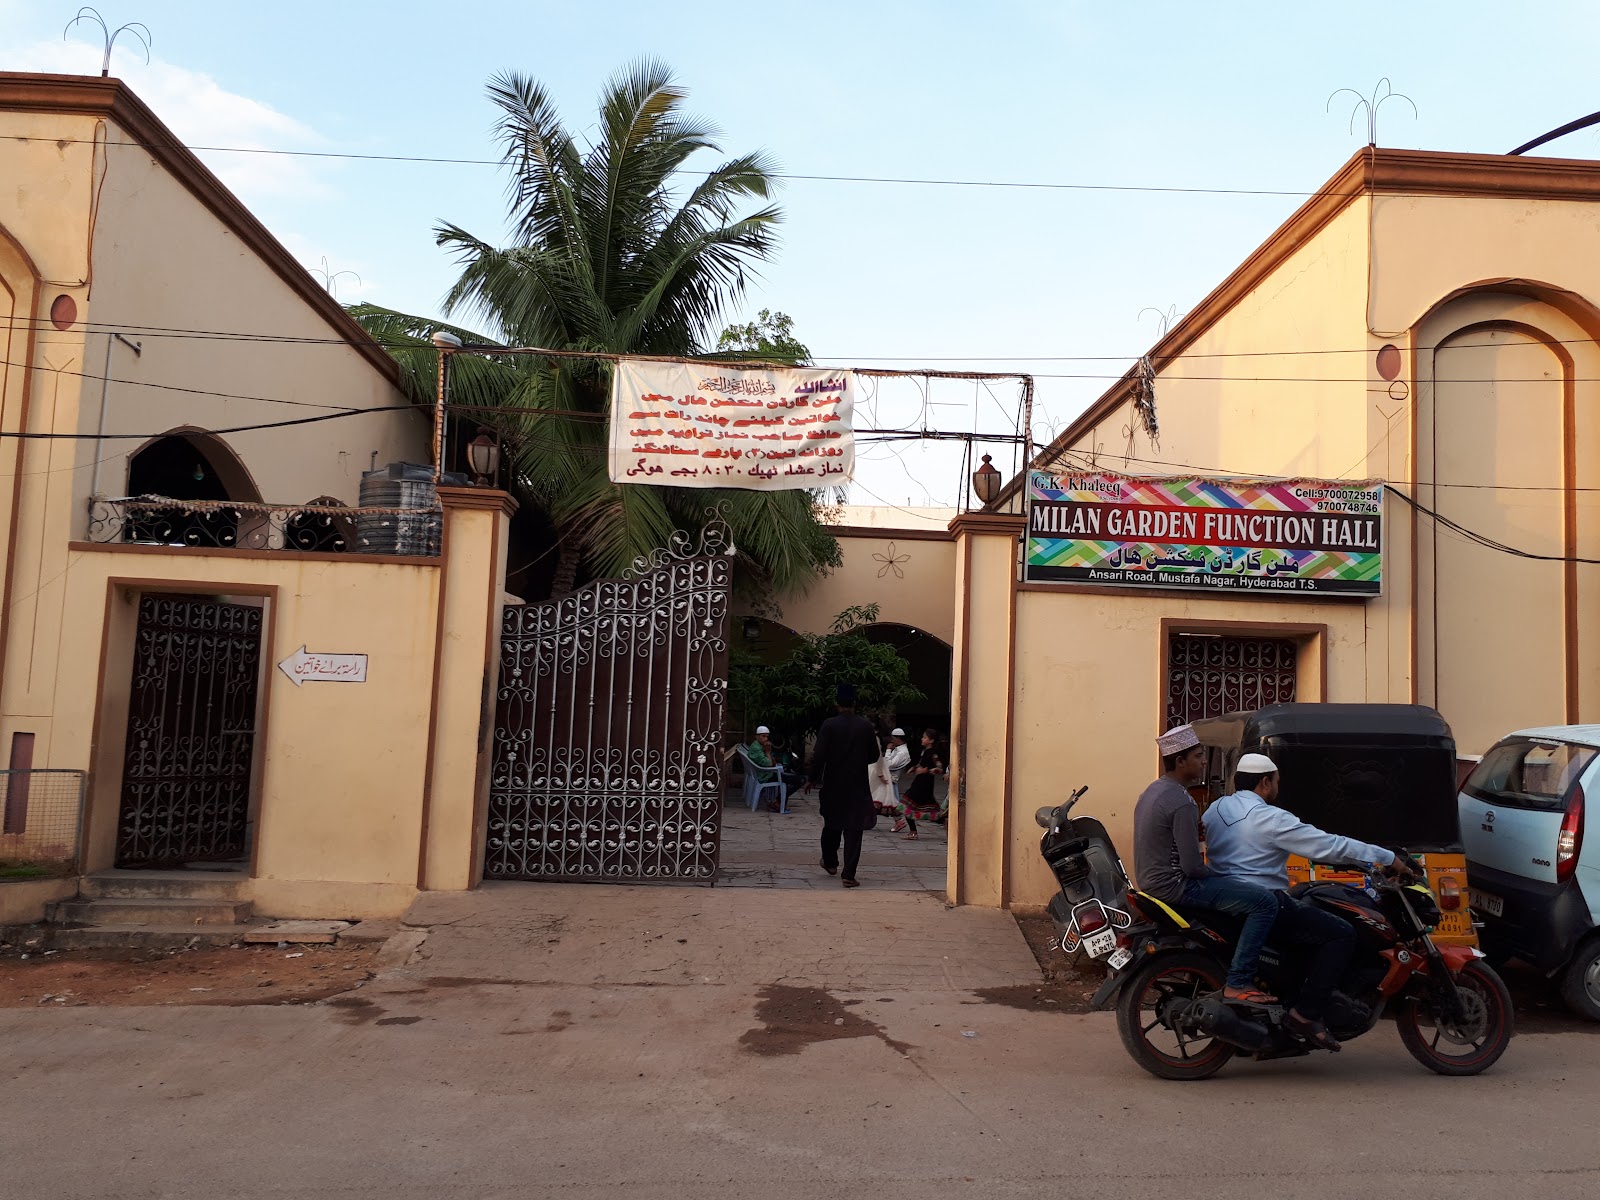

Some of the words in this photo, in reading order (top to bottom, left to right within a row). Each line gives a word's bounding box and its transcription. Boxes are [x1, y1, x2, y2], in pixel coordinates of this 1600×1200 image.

[818, 461, 844, 477] نماز
[1068, 477, 1122, 496] Khaleeq
[1317, 502, 1378, 513] 9700748746
[1032, 505, 1102, 534] MILAN
[1107, 509, 1197, 539] GARDEN
[1203, 513, 1316, 544] FUNCTION
[1321, 518, 1377, 549] HALL
[1266, 555, 1299, 576] ملن
[1088, 569, 1123, 581] Ansari
[1126, 571, 1156, 583] Road,
[1159, 572, 1201, 584] Mustafa
[1203, 575, 1237, 588] Nagar,
[1240, 576, 1296, 590] Hyderabad
[1299, 579, 1318, 590] T.S.
[1531, 858, 1551, 867] nano
[1258, 954, 1280, 967] YAMAHA
